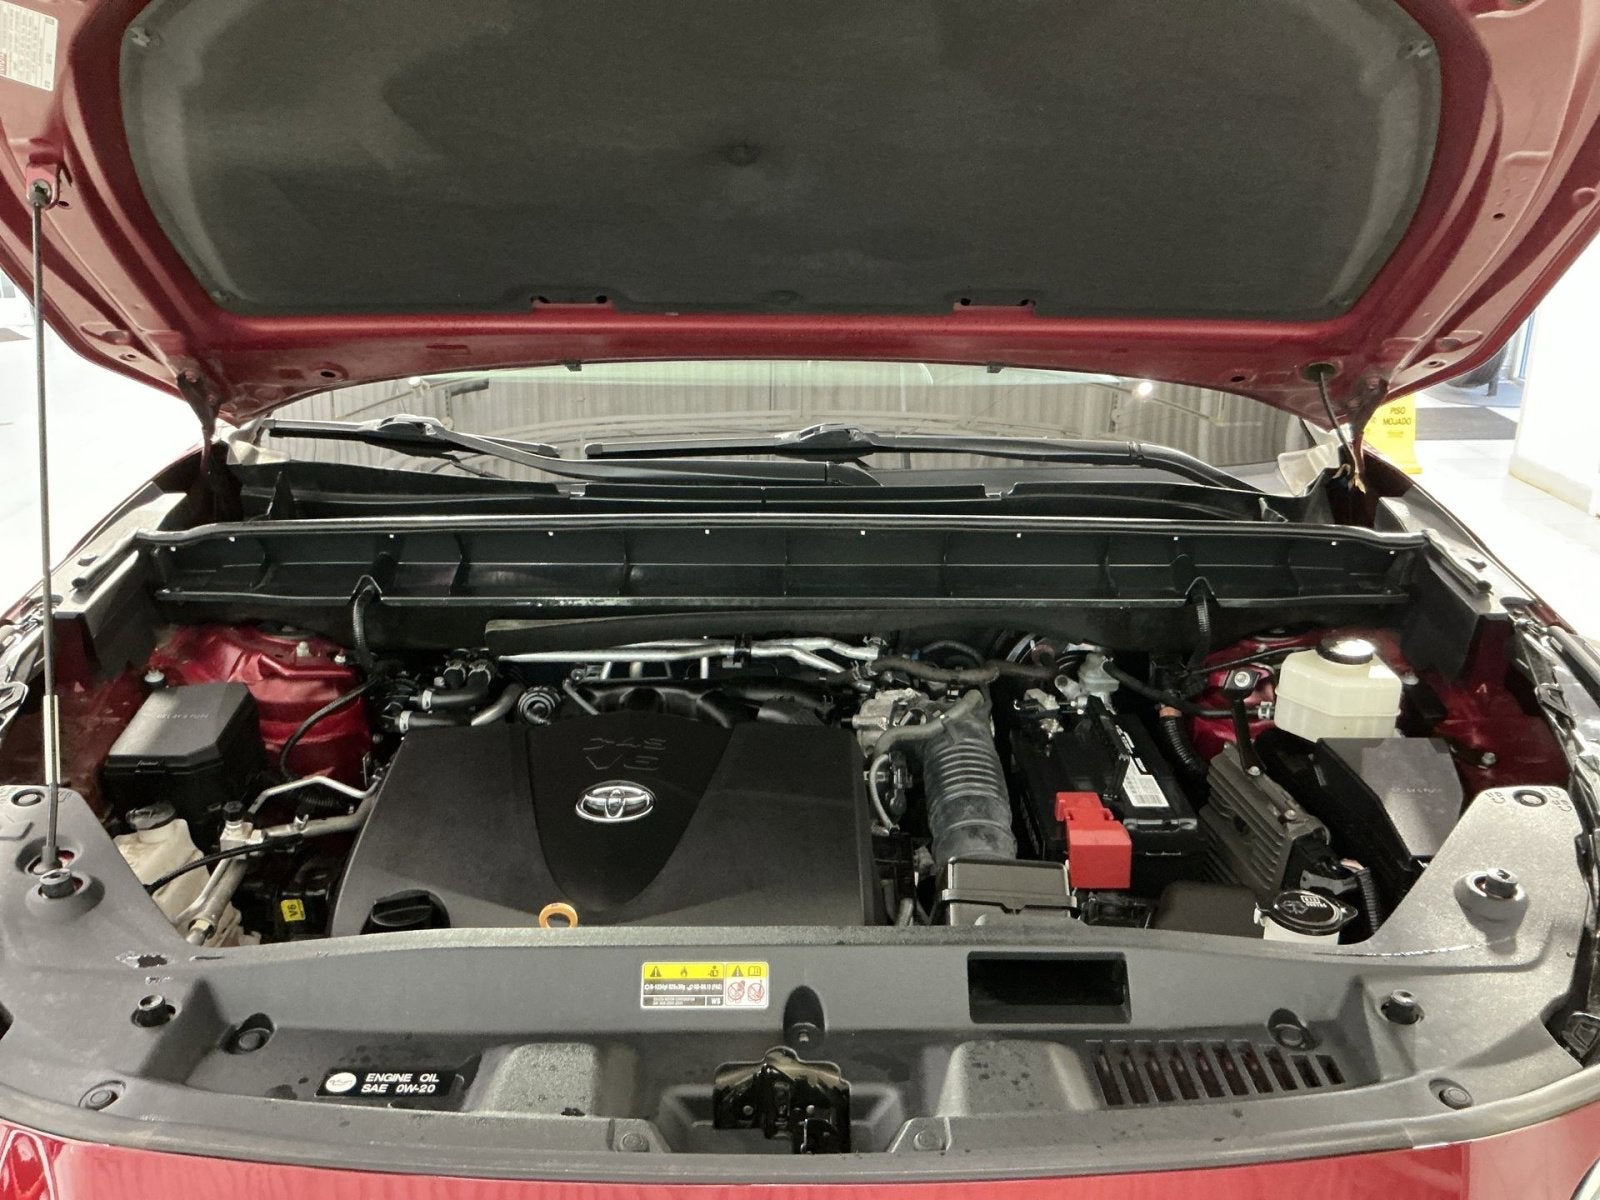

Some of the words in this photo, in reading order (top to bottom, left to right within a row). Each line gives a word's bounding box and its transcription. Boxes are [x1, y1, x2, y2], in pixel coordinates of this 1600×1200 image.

[1390, 406, 1406, 415] PISO
[1382, 417, 1412, 425] MOJADO
[287, 903, 299, 917] V6
[365, 1073, 413, 1082] ENGINE
[420, 1073, 440, 1082] OIL
[361, 1083, 389, 1093] SAE
[395, 1083, 436, 1093] 0W-20
